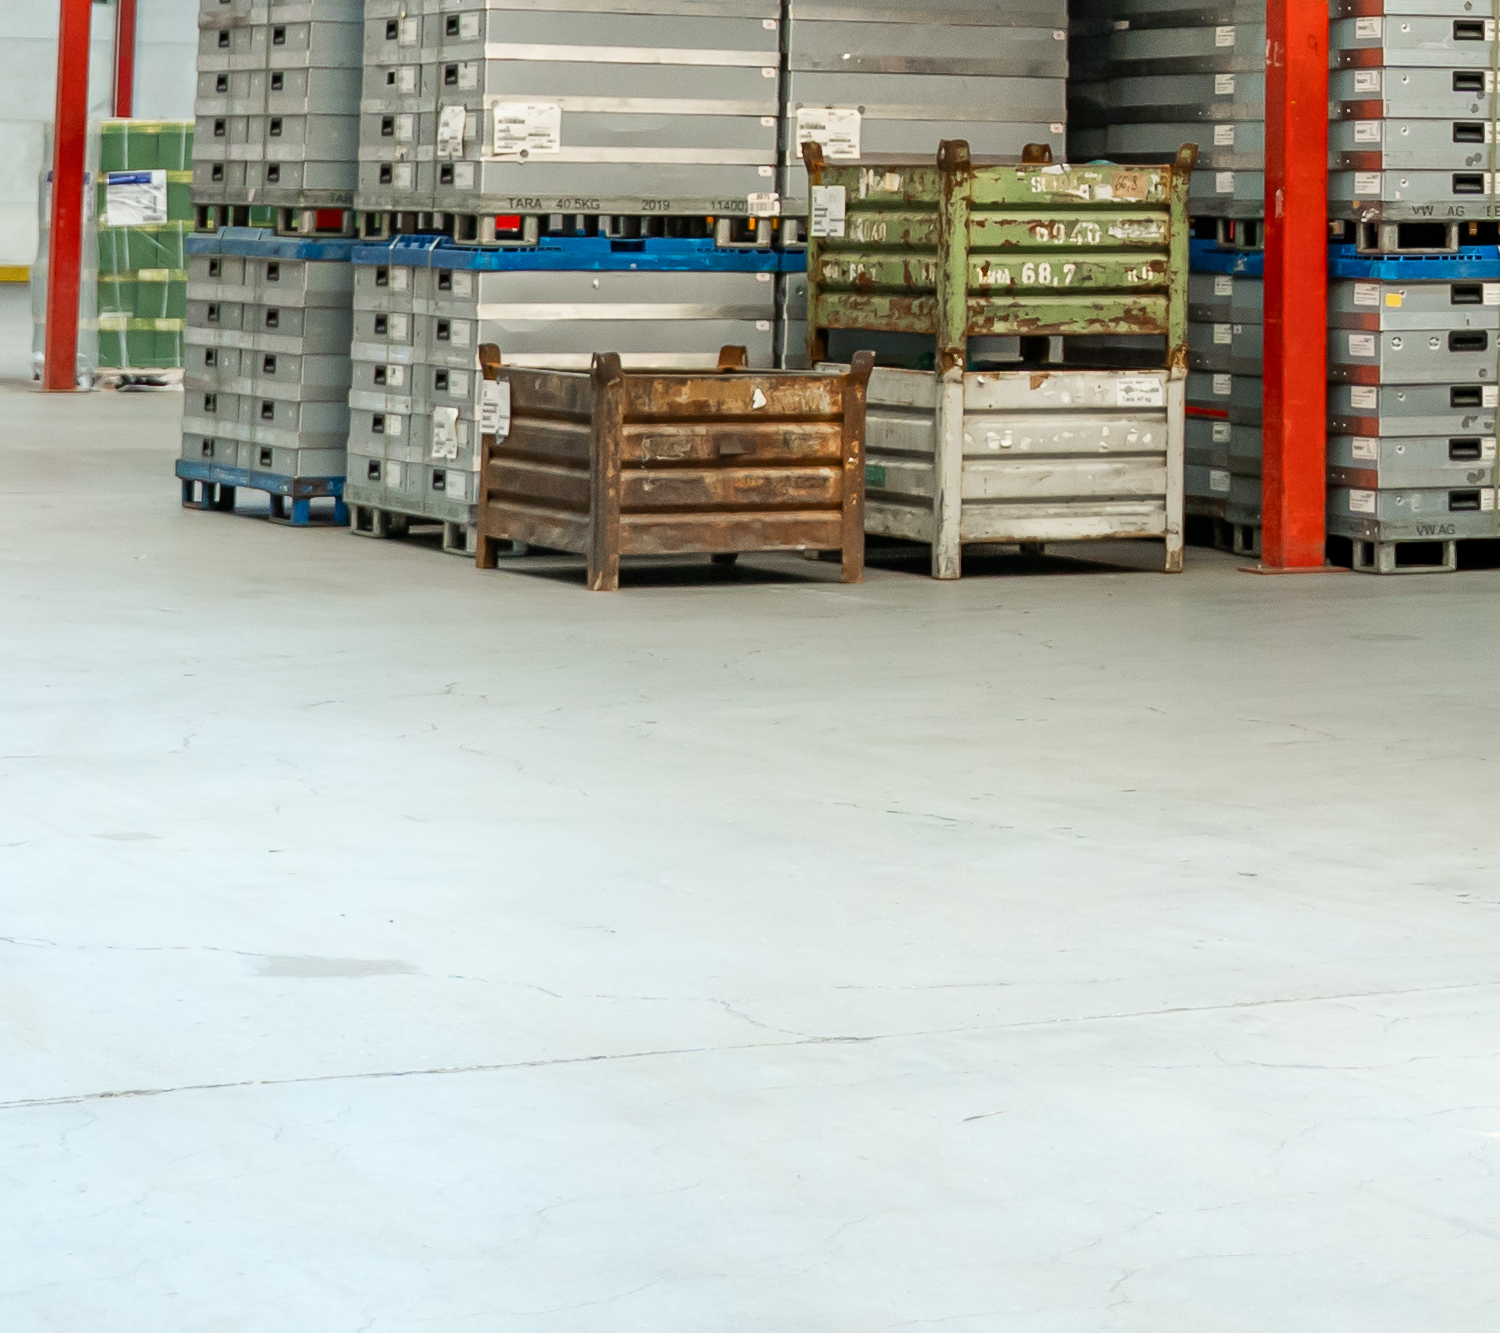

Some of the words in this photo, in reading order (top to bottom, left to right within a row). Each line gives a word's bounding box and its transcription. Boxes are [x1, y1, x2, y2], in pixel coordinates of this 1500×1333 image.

[507, 197, 543, 209] TARA
[556, 198, 600, 211] 40.5KG
[642, 200, 671, 211] 2019
[711, 200, 748, 211] 11400
[1412, 205, 1434, 216] VW
[1447, 206, 1465, 217] AG
[1416, 524, 1436, 536] VW
[1437, 523, 1455, 535] AG
